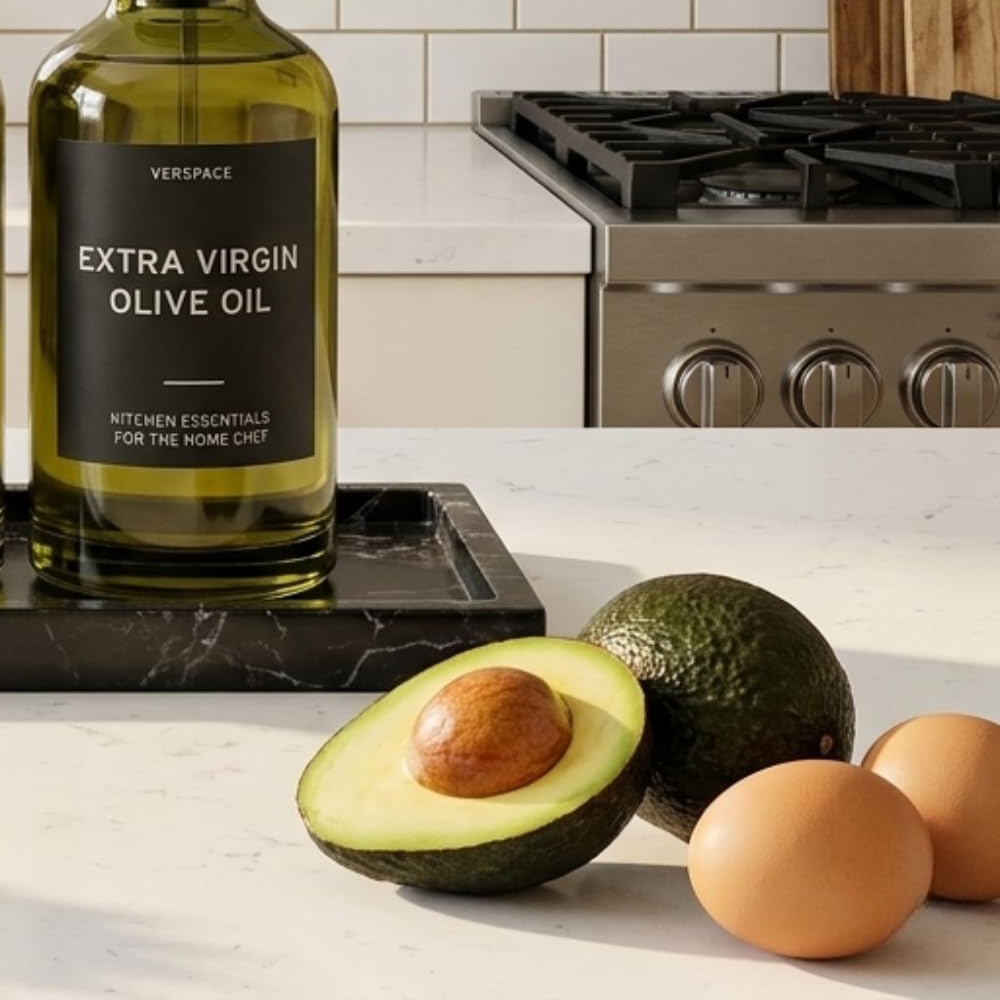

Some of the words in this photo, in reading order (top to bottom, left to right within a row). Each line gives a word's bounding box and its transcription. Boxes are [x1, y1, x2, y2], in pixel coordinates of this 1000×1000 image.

[150, 166, 232, 181] VERSPACE
[78, 245, 185, 275] EXTRA
[196, 243, 298, 275] VIRGIN
[109, 287, 209, 316] OLIVE
[220, 287, 272, 315] OIL
[180, 410, 271, 429] ESSENTIALS
[114, 430, 145, 446] FOR
[233, 428, 269, 446] CHEF
